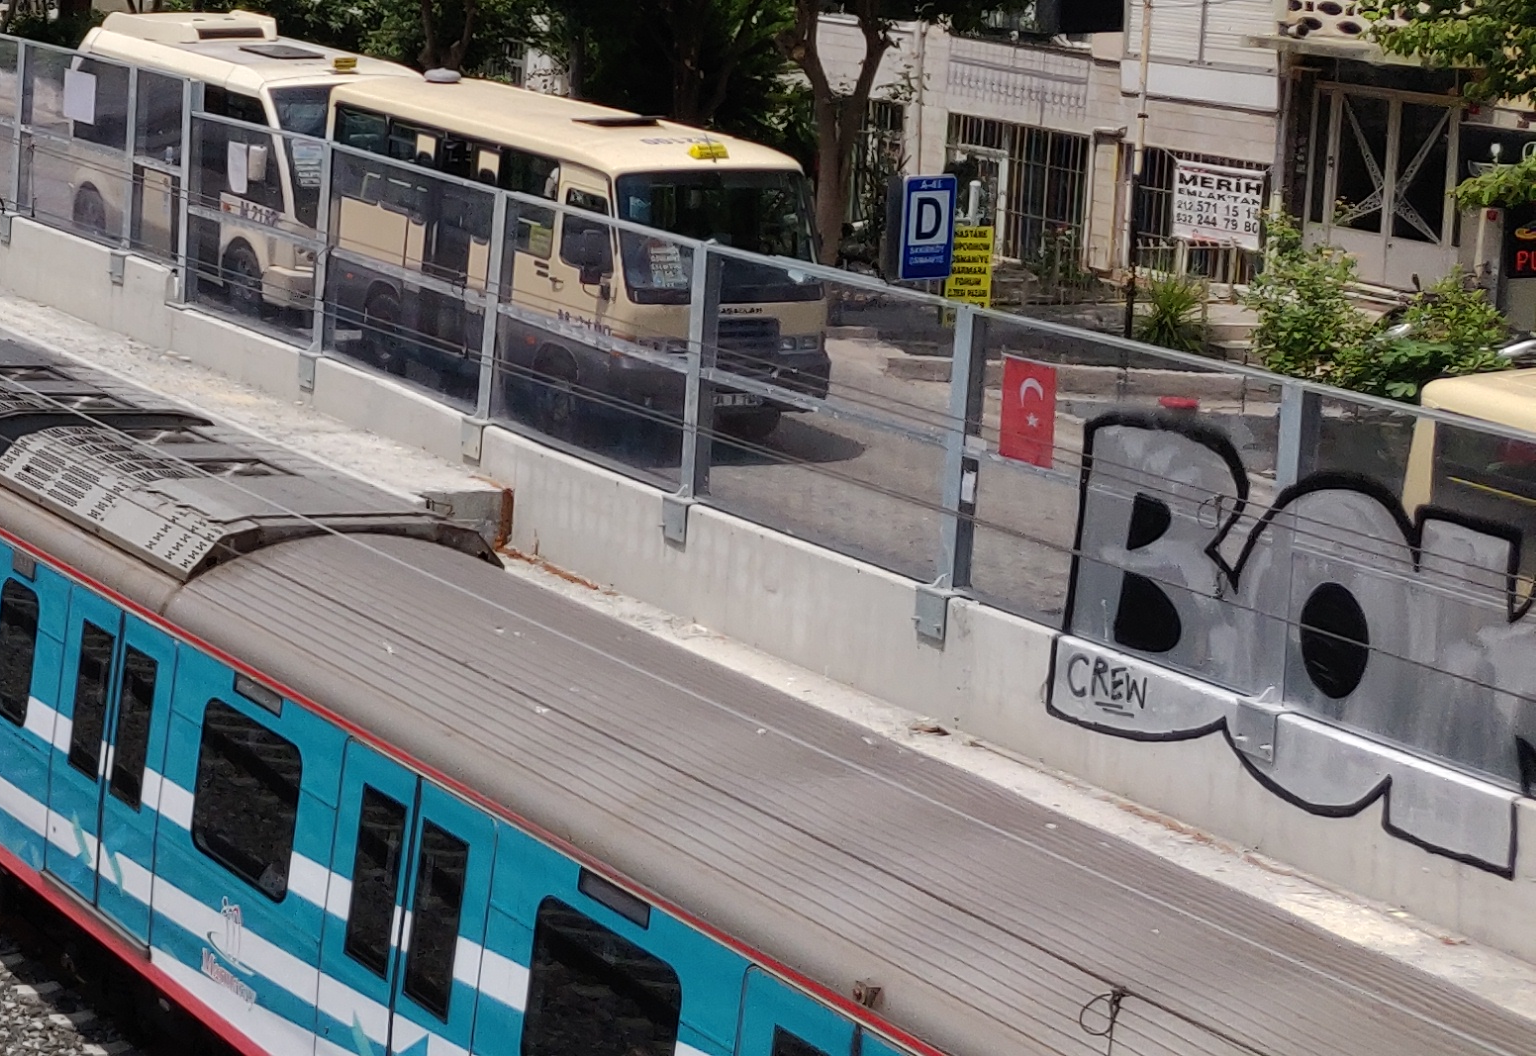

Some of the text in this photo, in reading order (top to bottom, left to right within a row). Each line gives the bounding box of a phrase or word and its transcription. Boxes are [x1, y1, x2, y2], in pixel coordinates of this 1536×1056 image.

[1178, 172, 1261, 196] MERİH
[915, 197, 942, 241] D
[1197, 200, 1217, 215] 571
[1225, 205, 1240, 218] 15
[1066, 651, 1148, 711] CREW
